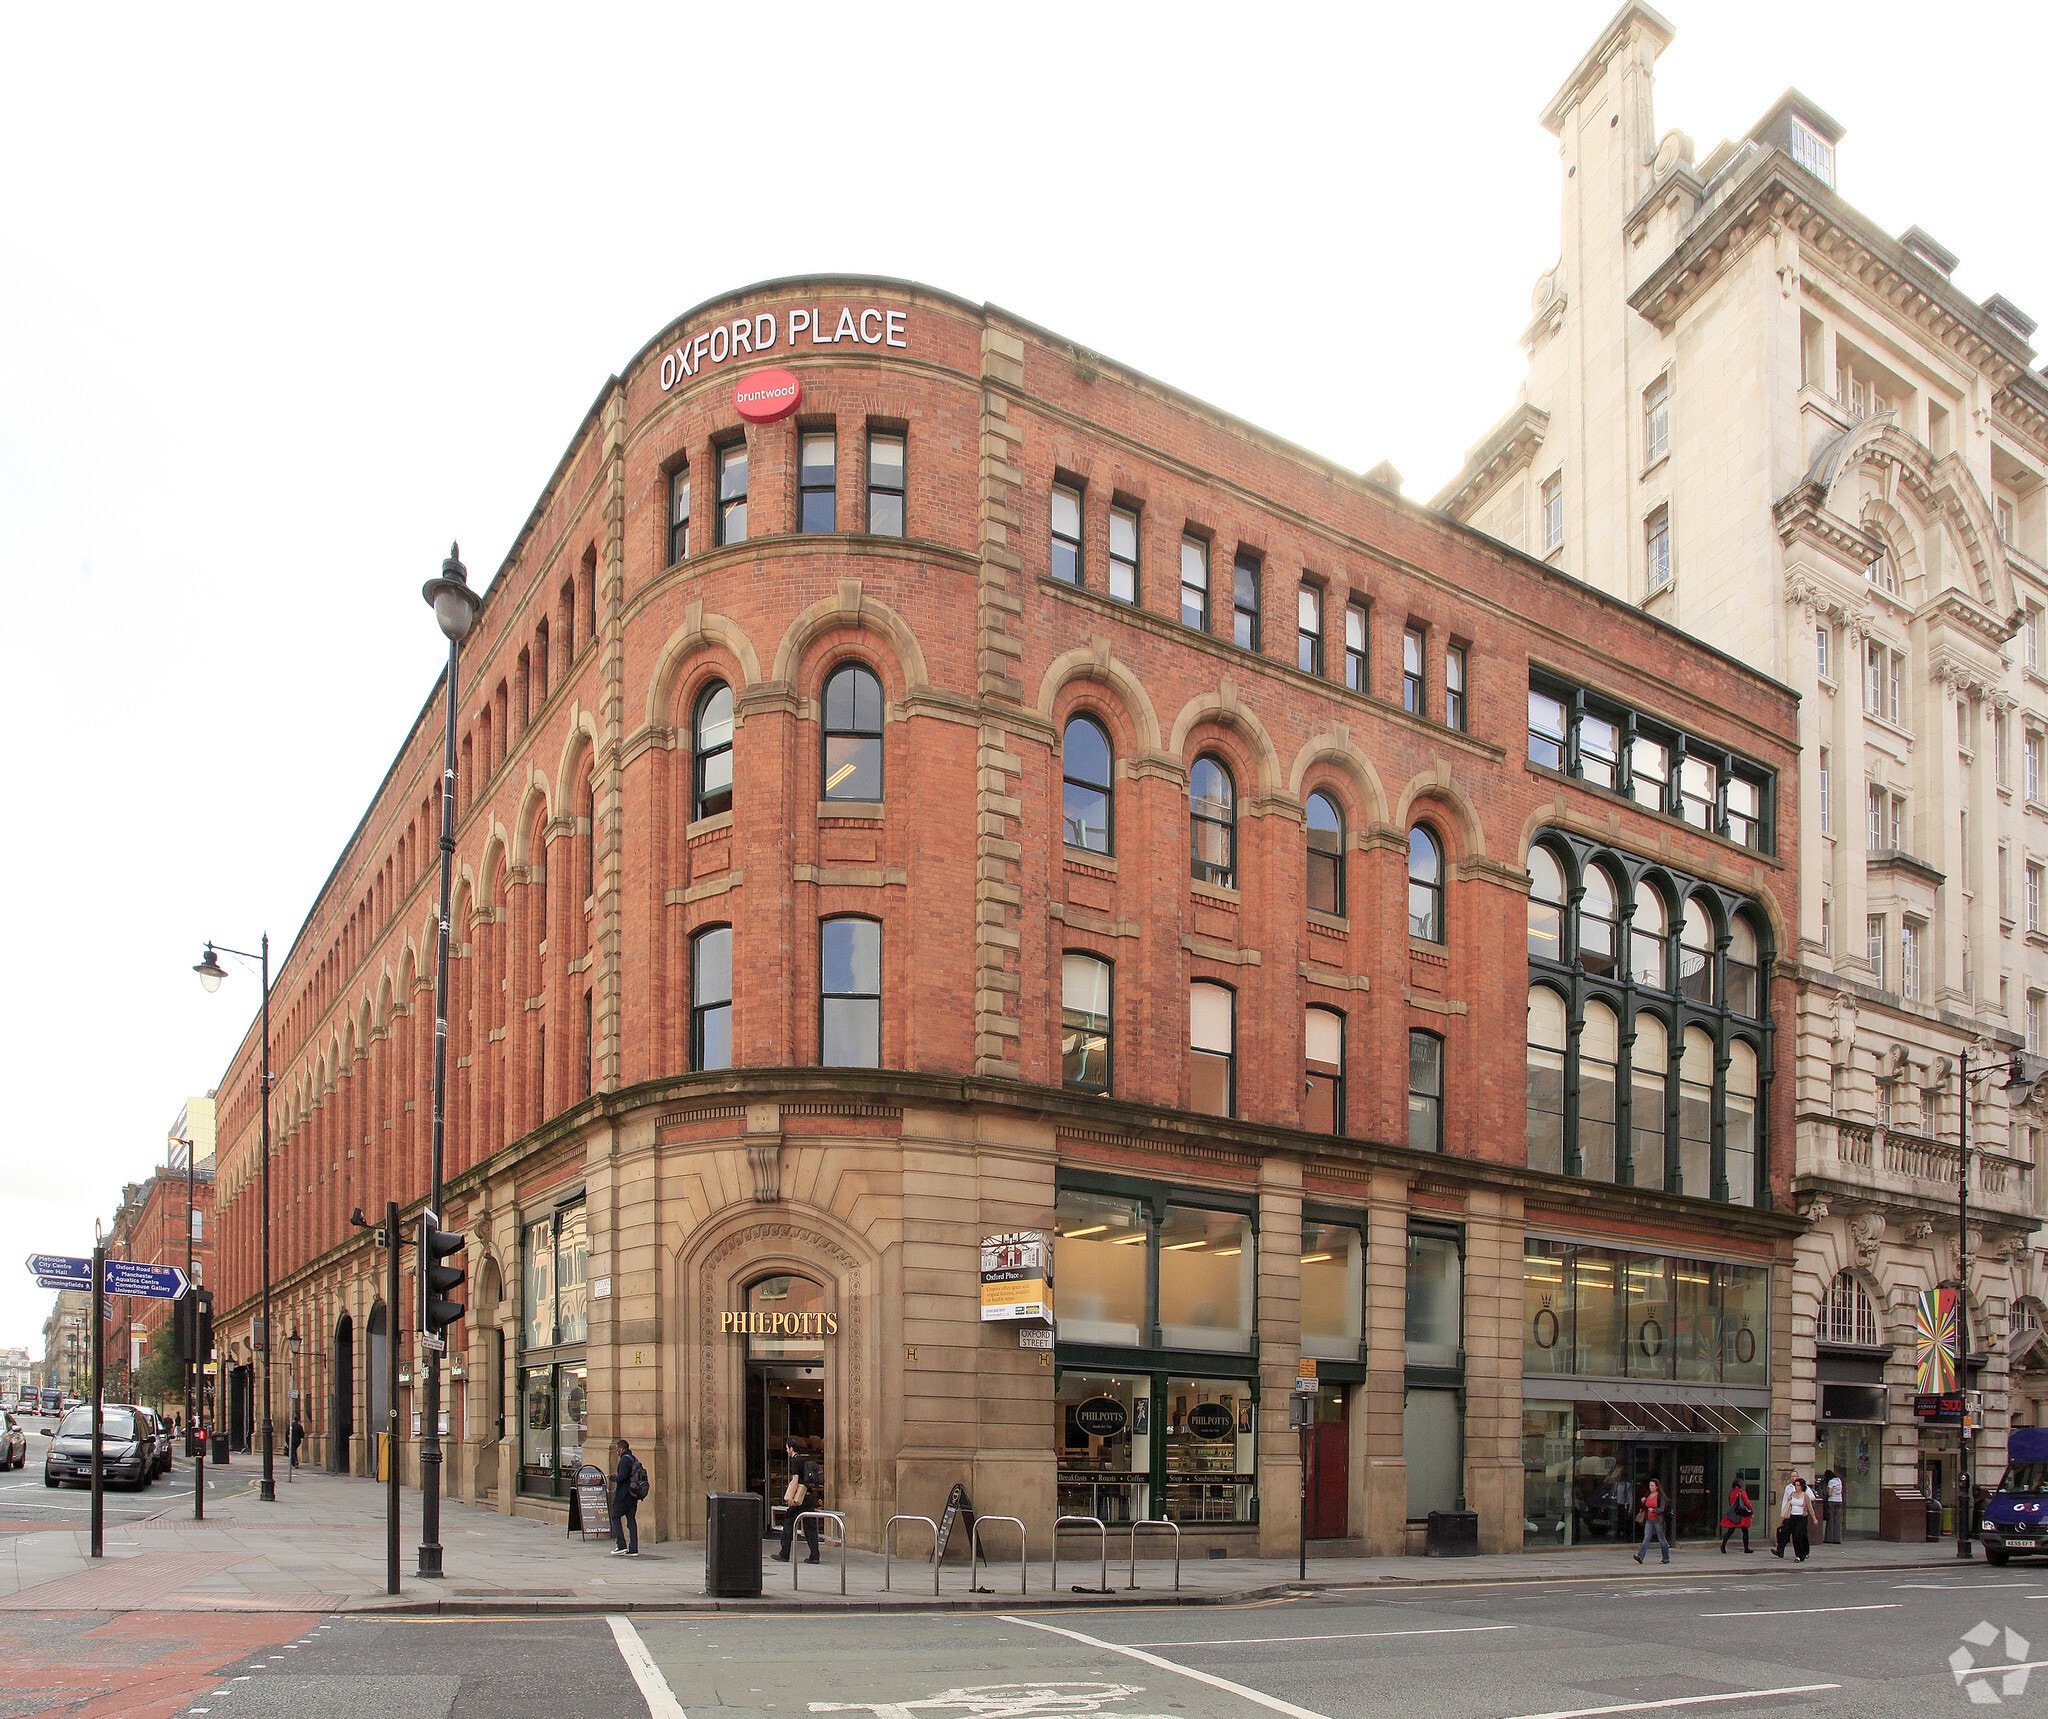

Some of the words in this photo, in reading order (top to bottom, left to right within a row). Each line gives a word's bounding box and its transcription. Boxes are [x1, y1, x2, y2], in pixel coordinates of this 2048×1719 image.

[660, 313, 777, 391] OXFORD
[788, 307, 907, 348] PLACE
[737, 383, 795, 403] bruntwood
[39, 1255, 66, 1263] Metrolink
[121, 1271, 153, 1279] Manchester
[986, 1273, 1005, 1281] Oxford
[1005, 1271, 1020, 1279] Place
[115, 1281, 150, 1290] Cornerhouse
[720, 1311, 838, 1334] PHILPOTTS
[1021, 1330, 1050, 1339] OXFORD
[1022, 1338, 1049, 1347] STREET
[906, 1347, 917, 1362] H
[1039, 1353, 1049, 1366] H
[1081, 1411, 1123, 1421] PHILPOTTS
[1191, 1416, 1230, 1425] PHILPOTTS
[1098, 1474, 1116, 1482] Roasts
[1169, 1475, 1183, 1483] Soup
[1680, 1475, 1704, 1484] PLACE
[2013, 1503, 2040, 1512] G4S
